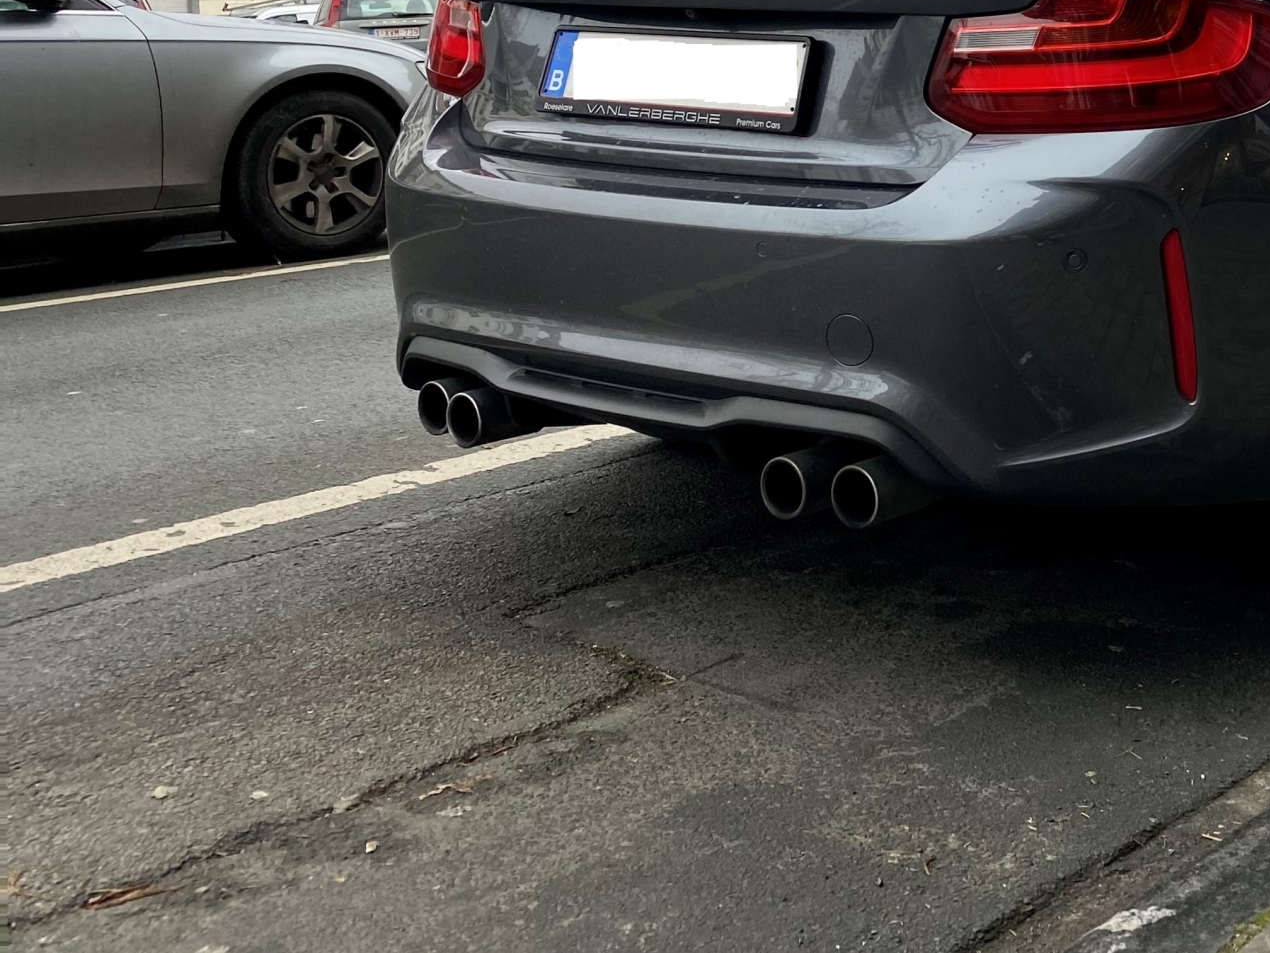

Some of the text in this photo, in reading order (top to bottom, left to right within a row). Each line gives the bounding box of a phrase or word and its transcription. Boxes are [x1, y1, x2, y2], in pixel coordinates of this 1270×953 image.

[548, 69, 564, 91] B
[543, 101, 781, 130] Roeselare VANLERBERGHE Premium Cars
